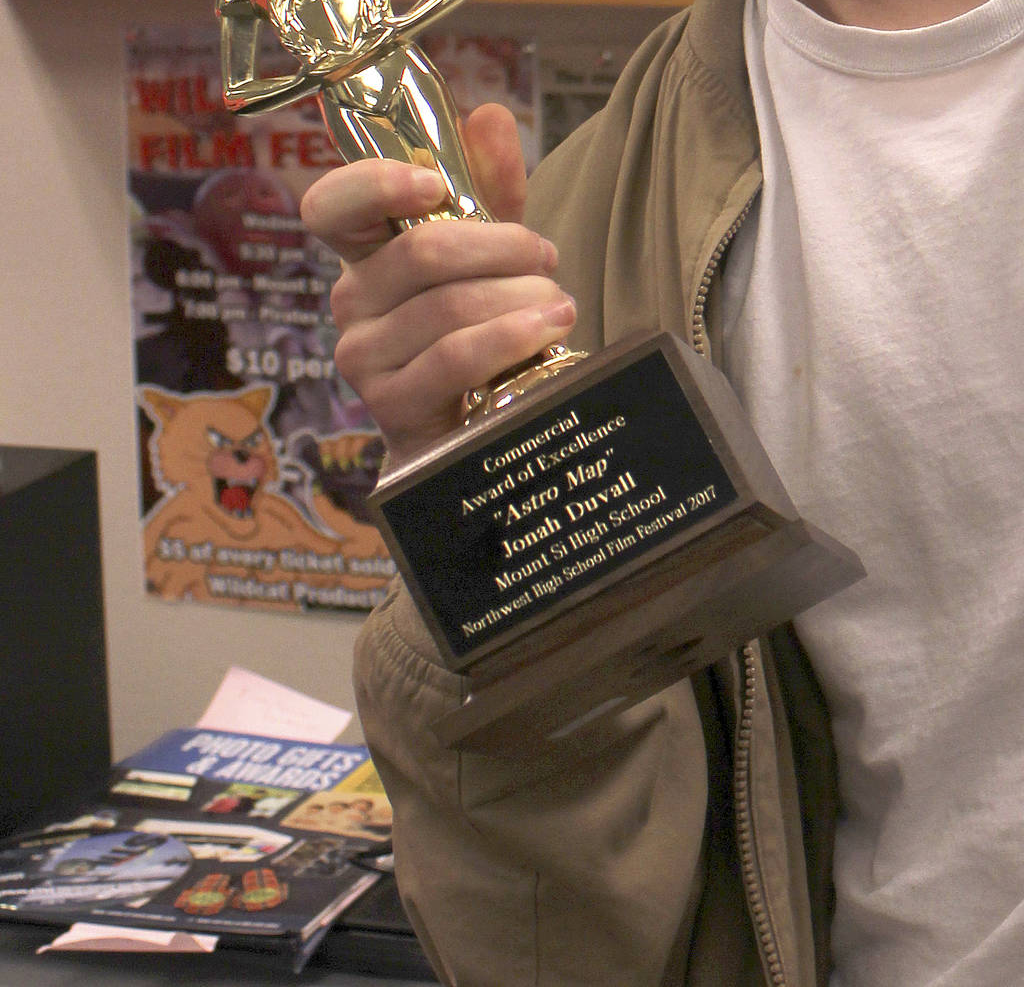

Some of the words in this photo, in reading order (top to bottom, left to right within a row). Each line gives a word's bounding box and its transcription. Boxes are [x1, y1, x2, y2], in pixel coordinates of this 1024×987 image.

[140, 130, 255, 171] FILM
[226, 347, 281, 377] $10
[461, 473, 516, 516] Award
[517, 462, 536, 483] of
[536, 415, 627, 472] Excellence
[482, 410, 580, 474] Commercial
[493, 485, 560, 527] "Astro
[565, 447, 614, 492] Map"
[502, 516, 562, 559] Jonah
[565, 471, 637, 522] Duvall
[216, 547, 276, 570] every
[461, 590, 533, 639] Northwest
[531, 572, 564, 599] High
[562, 547, 608, 582] School
[606, 533, 637, 557] Film
[635, 502, 688, 540] Festival
[686, 484, 717, 512] 2017
[494, 552, 552, 592] Mount
[550, 540, 569, 561] Si
[568, 520, 609, 552] High
[608, 485, 668, 528] School
[180, 732, 282, 765] PHOTO
[276, 744, 363, 773] GIFTS
[213, 760, 342, 792] AWARDS
